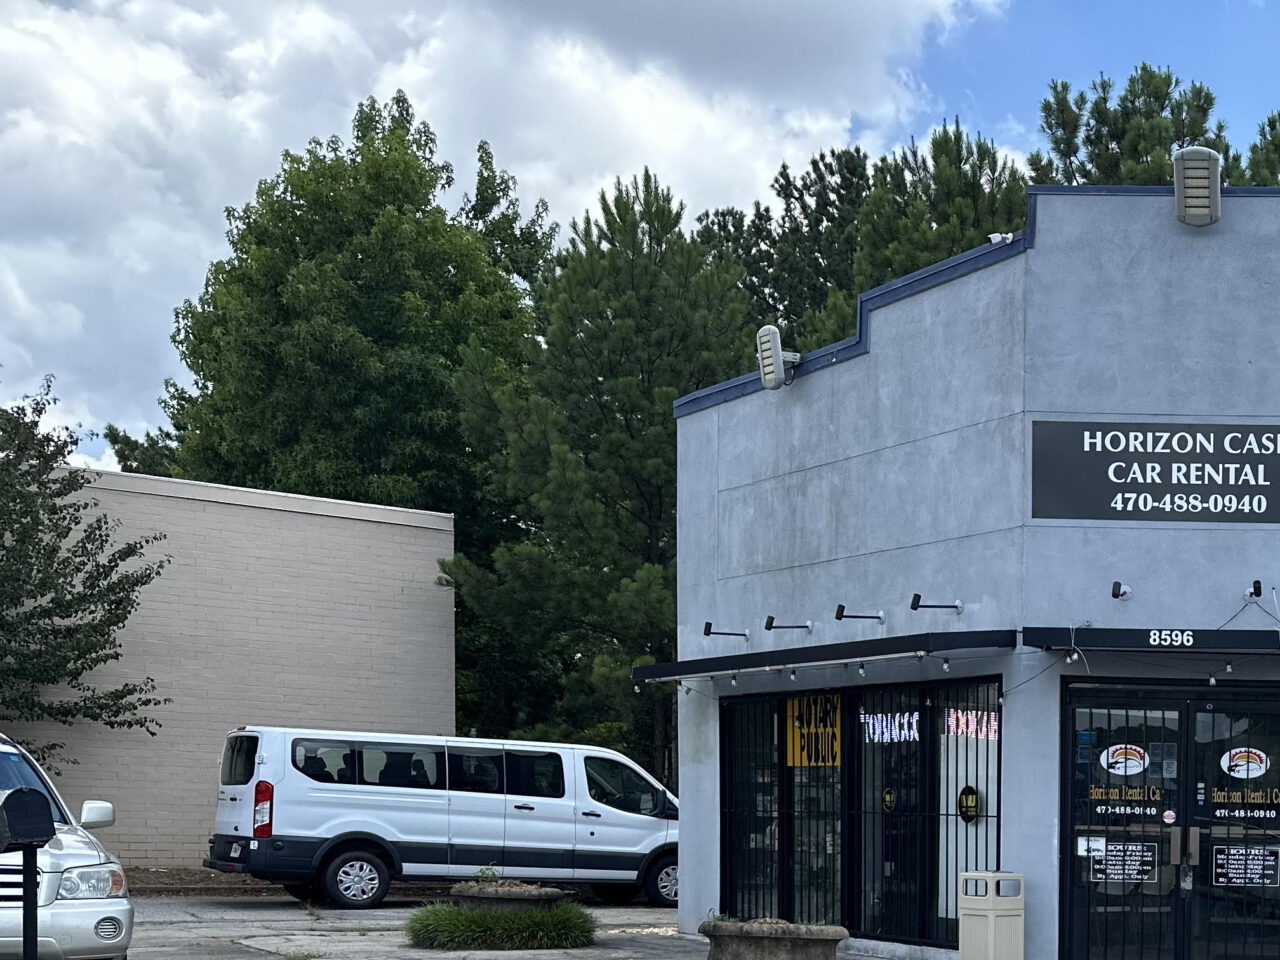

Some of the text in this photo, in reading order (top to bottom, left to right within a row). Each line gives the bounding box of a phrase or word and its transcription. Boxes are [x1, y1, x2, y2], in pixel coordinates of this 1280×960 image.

[1083, 431, 1215, 454] HORIZON
[1107, 462, 1271, 486] CAR RENTAL
[1110, 492, 1268, 514] 470-488-0940
[1149, 630, 1194, 647] 8596
[1089, 783, 1120, 801] Horion
[1150, 785, 1163, 801] Ca
